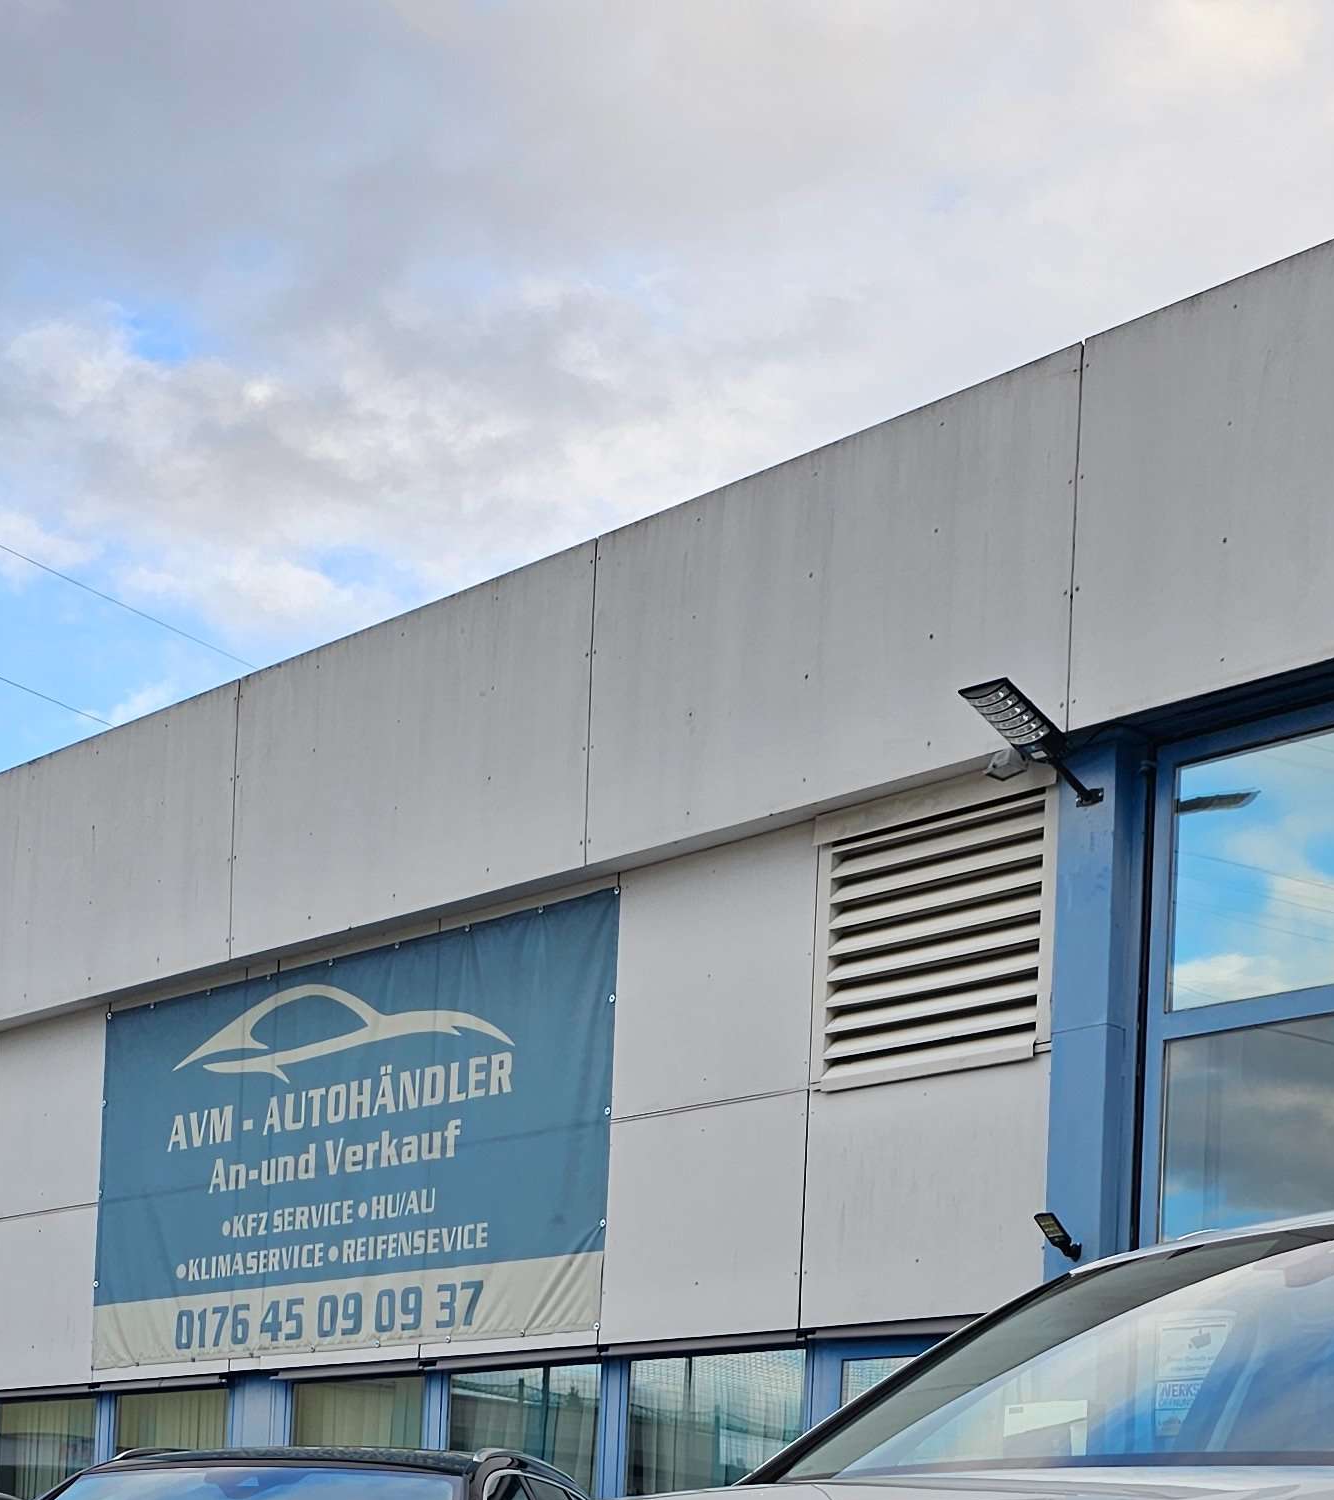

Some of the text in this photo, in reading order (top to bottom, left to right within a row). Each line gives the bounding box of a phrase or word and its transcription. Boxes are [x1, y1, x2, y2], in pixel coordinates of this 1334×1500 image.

[167, 1105, 234, 1153] AVM
[262, 1051, 513, 1136] AUTOHÄNDLER
[208, 1119, 462, 1194] An-und Verkauf
[188, 1222, 489, 1281] KLIMASERVICE REIFENSEVICE
[272, 1200, 354, 1233] SERVICE
[175, 1280, 484, 1350] 0176 45 09 09 37
